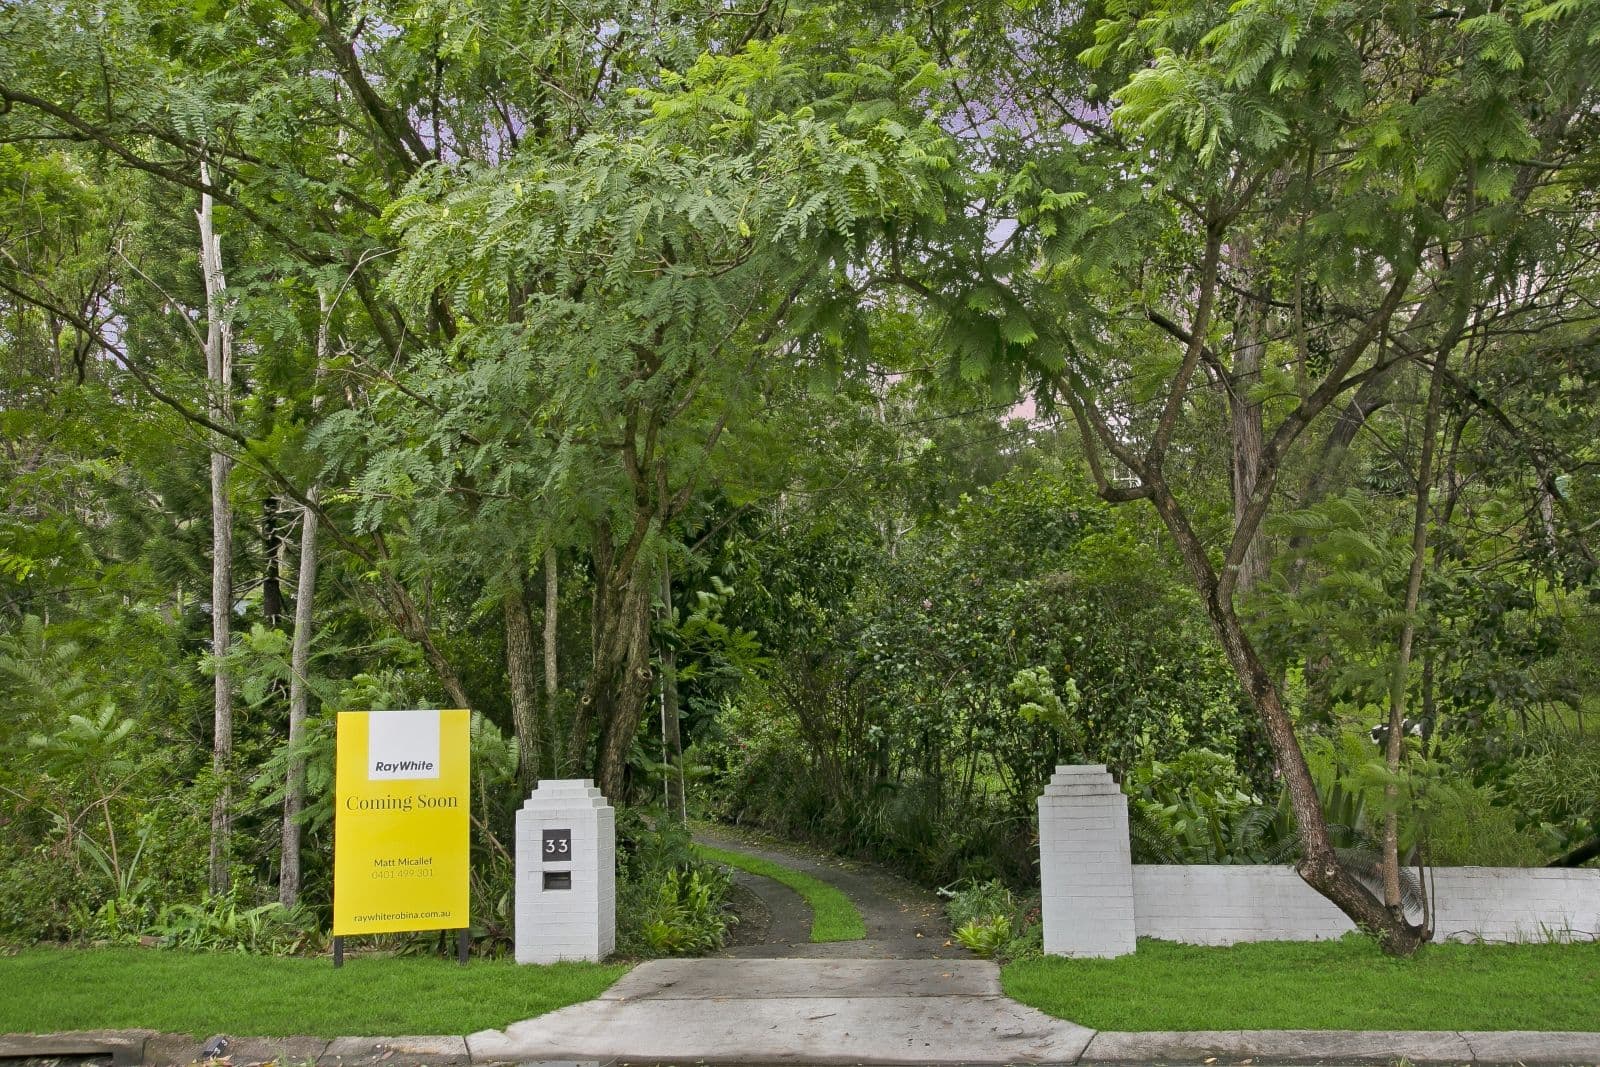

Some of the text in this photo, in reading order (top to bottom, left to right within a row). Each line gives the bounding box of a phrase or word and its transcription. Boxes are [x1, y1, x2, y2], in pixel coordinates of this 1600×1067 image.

[346, 794, 458, 812] Coming Soon
[545, 839, 568, 853] 33
[374, 857, 433, 867] Matt Micallef
[371, 870, 394, 880] 0401
[354, 910, 451, 923] raywhiterobina.com.au
